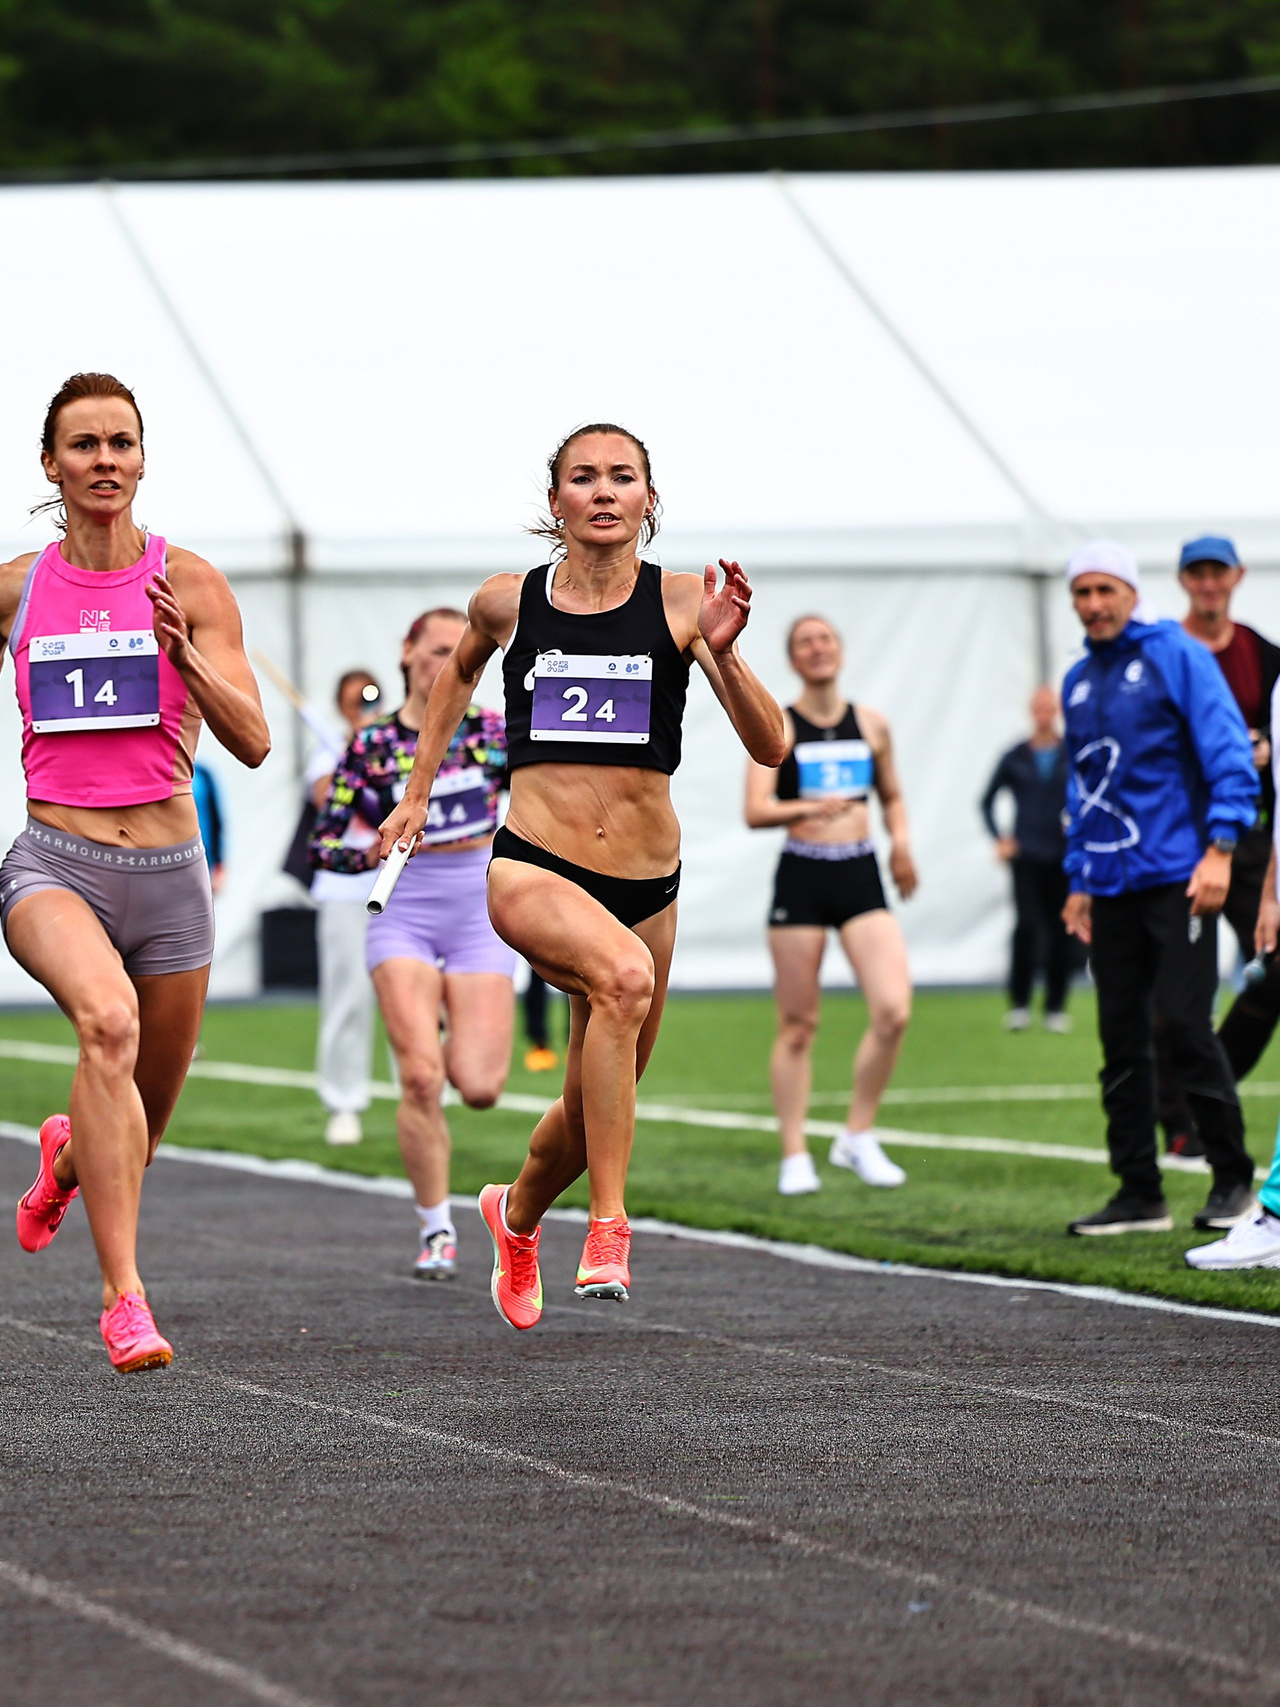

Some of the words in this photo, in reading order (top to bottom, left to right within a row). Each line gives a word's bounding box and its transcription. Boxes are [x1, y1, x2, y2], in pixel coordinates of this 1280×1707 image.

[65, 668, 84, 708] 1
[94, 680, 118, 706] 4
[561, 686, 588, 722] 2
[594, 699, 617, 723] 4
[43, 833, 113, 863] ARMOUR
[138, 845, 200, 867] ARMOUR
